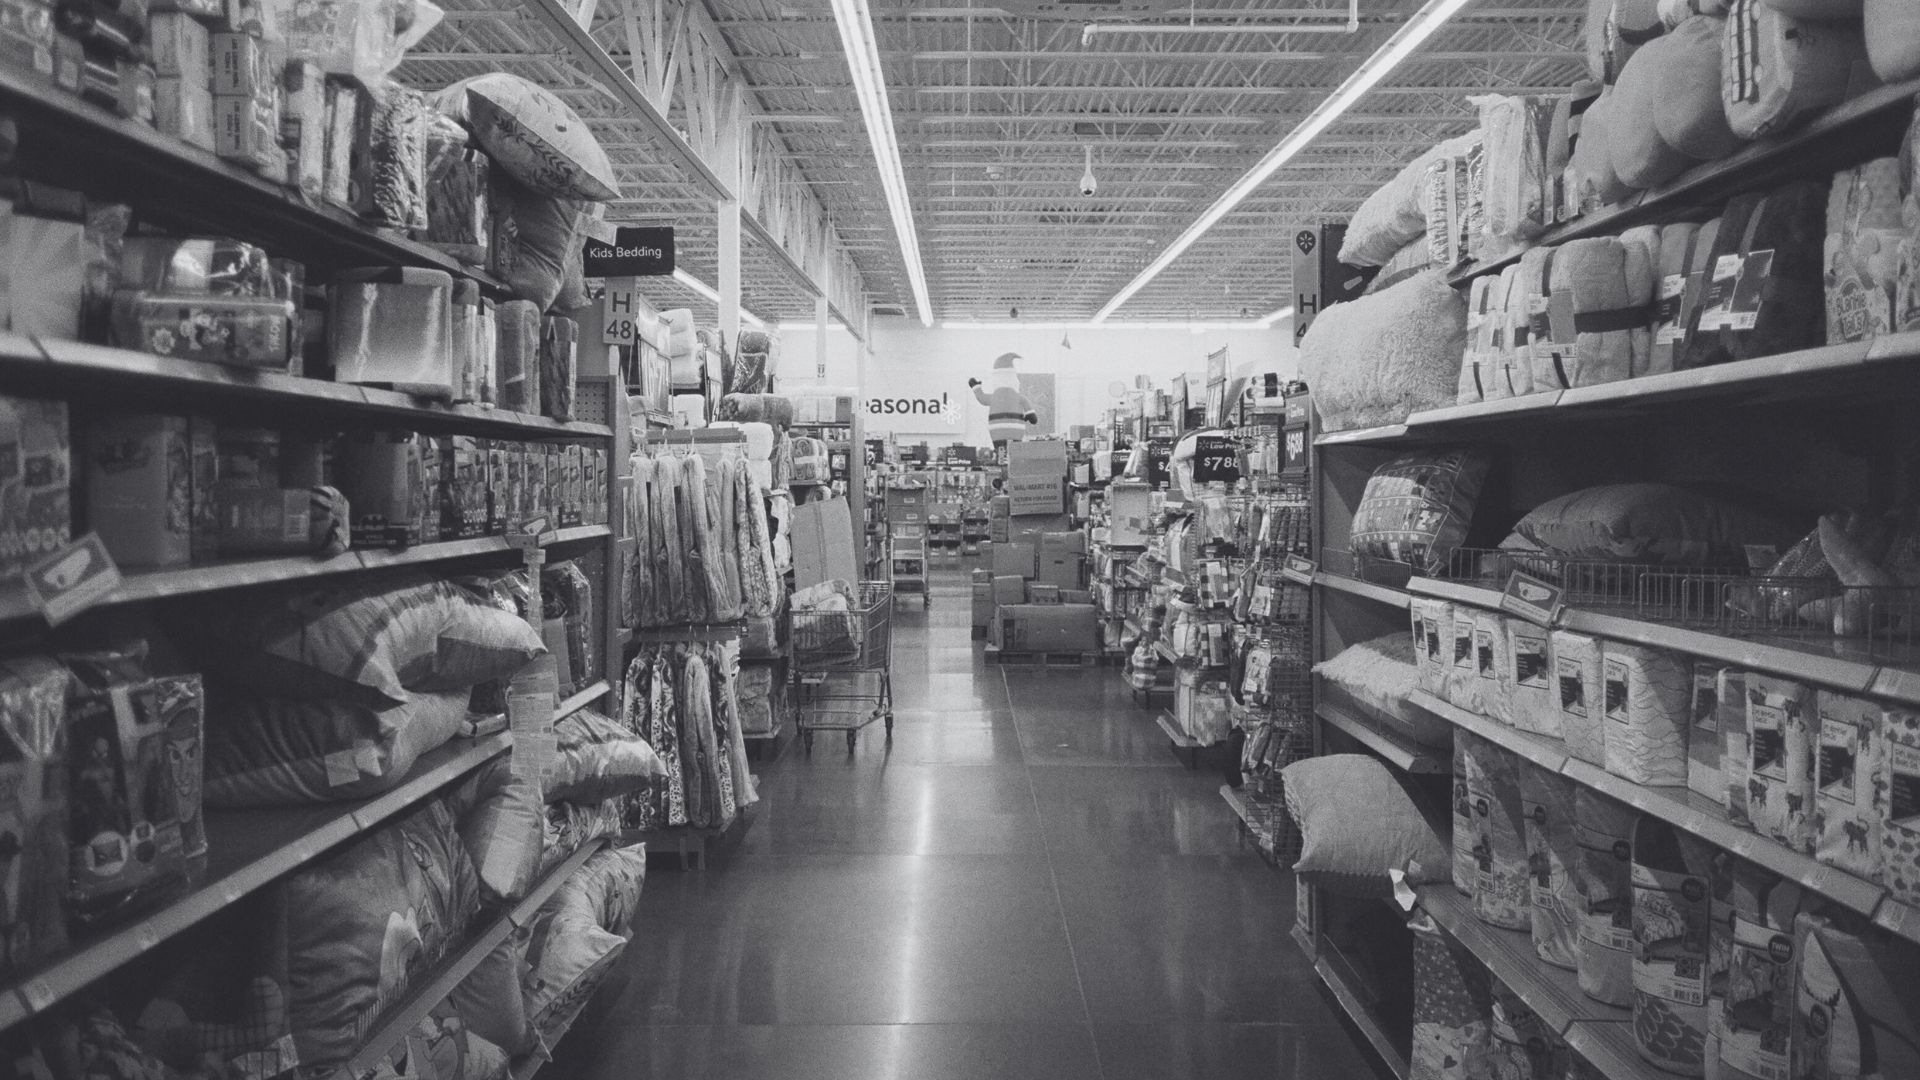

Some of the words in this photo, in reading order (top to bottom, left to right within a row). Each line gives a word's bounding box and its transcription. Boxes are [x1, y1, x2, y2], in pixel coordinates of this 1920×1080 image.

[589, 247, 613, 258] Kids
[616, 246, 662, 259] Bedding
[612, 291, 630, 313] H
[1299, 294, 1317, 314] H
[606, 319, 631, 339] 48
